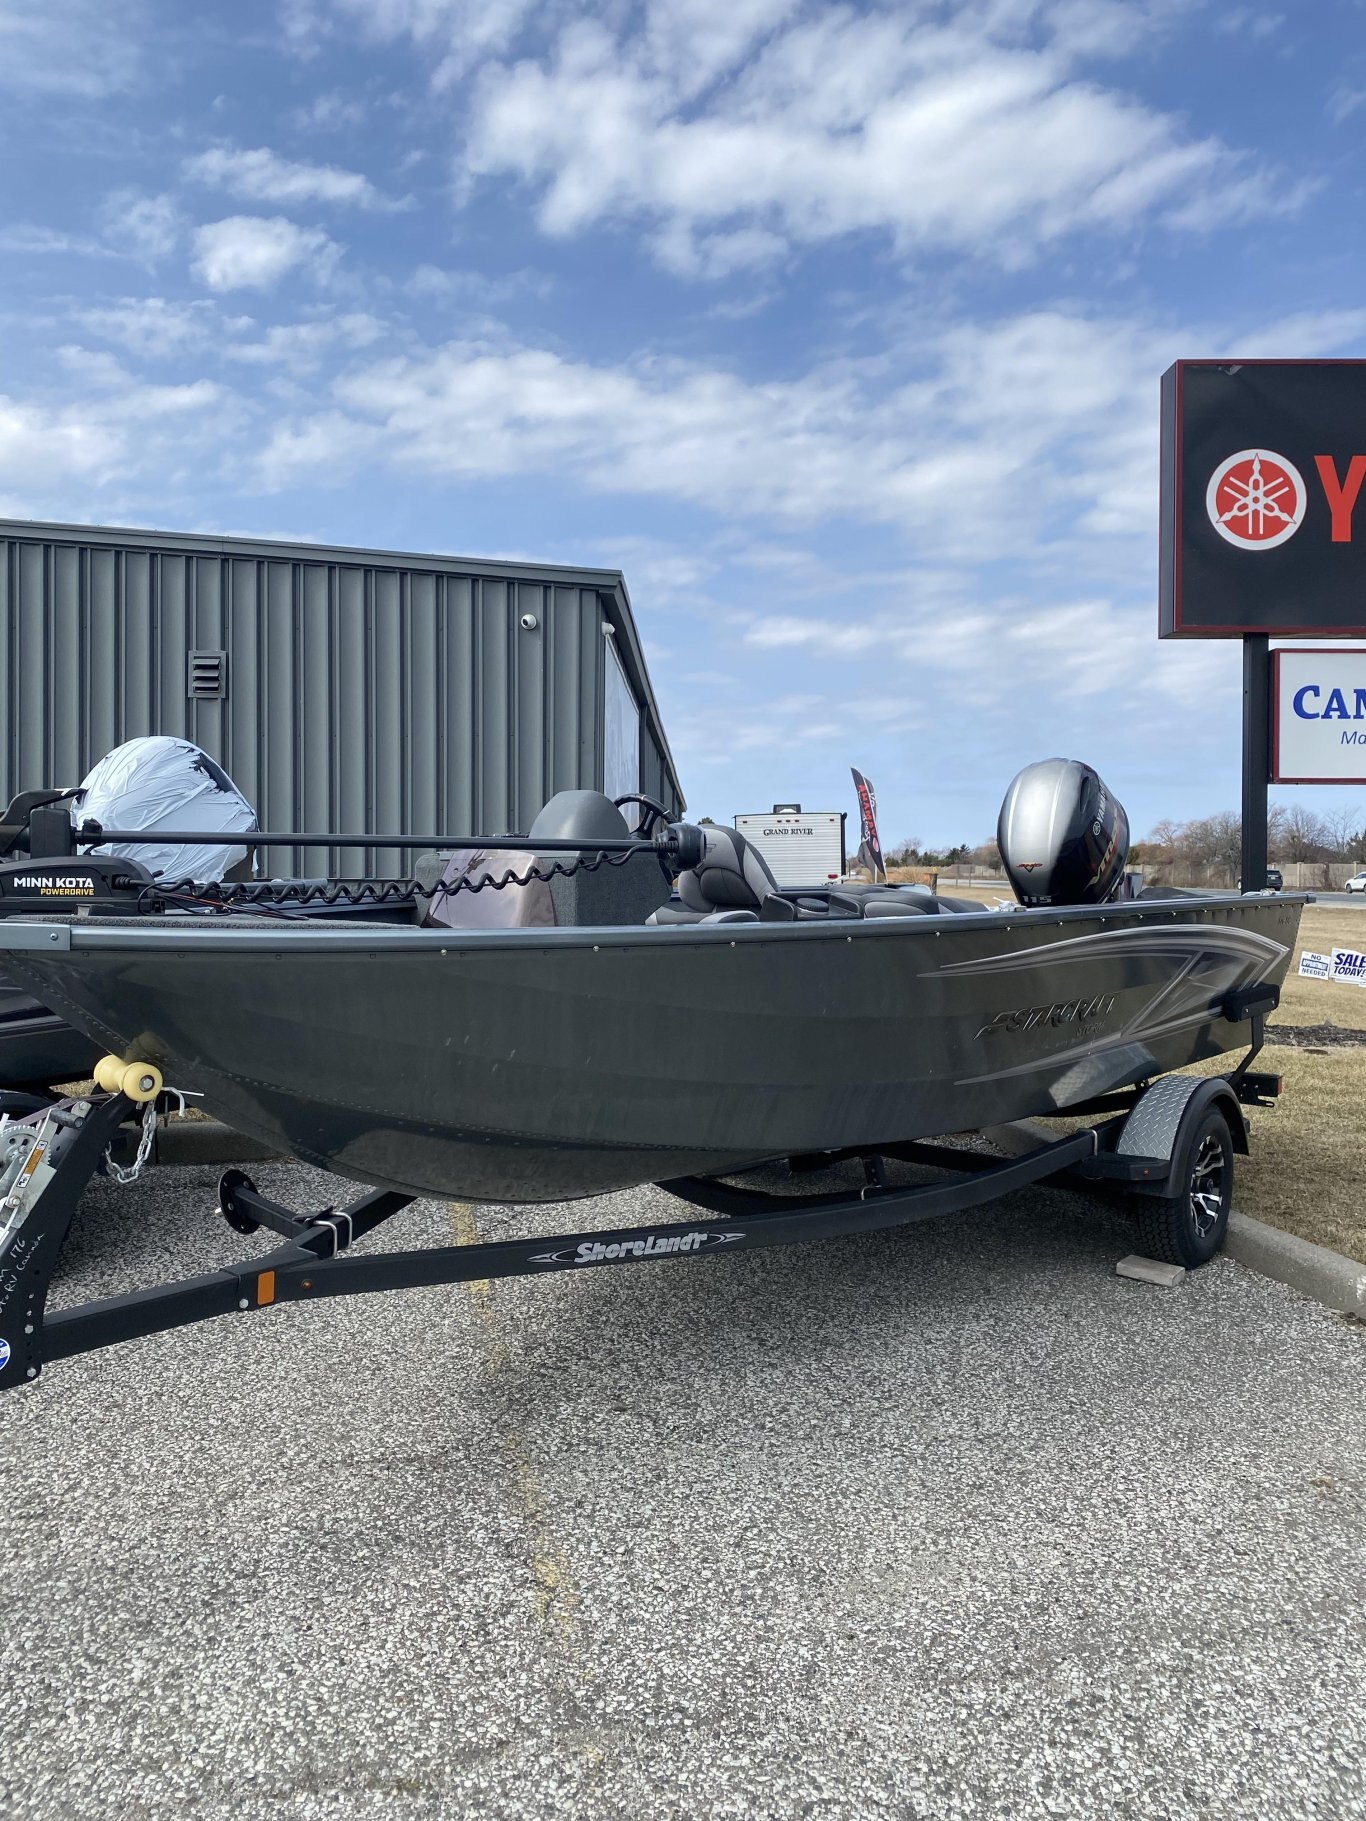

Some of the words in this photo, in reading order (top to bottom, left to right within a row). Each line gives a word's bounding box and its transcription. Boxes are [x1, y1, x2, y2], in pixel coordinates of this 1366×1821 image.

[763, 828, 789, 836] GRAND
[13, 877, 53, 887] MINN
[55, 877, 94, 887] KOTA
[40, 888, 95, 896] POWERDRIVE
[1022, 895, 1052, 904] 115
[1334, 953, 1366, 969] SALE
[1301, 967, 1326, 977] NEEDED
[10, 1236, 26, 1259] 176
